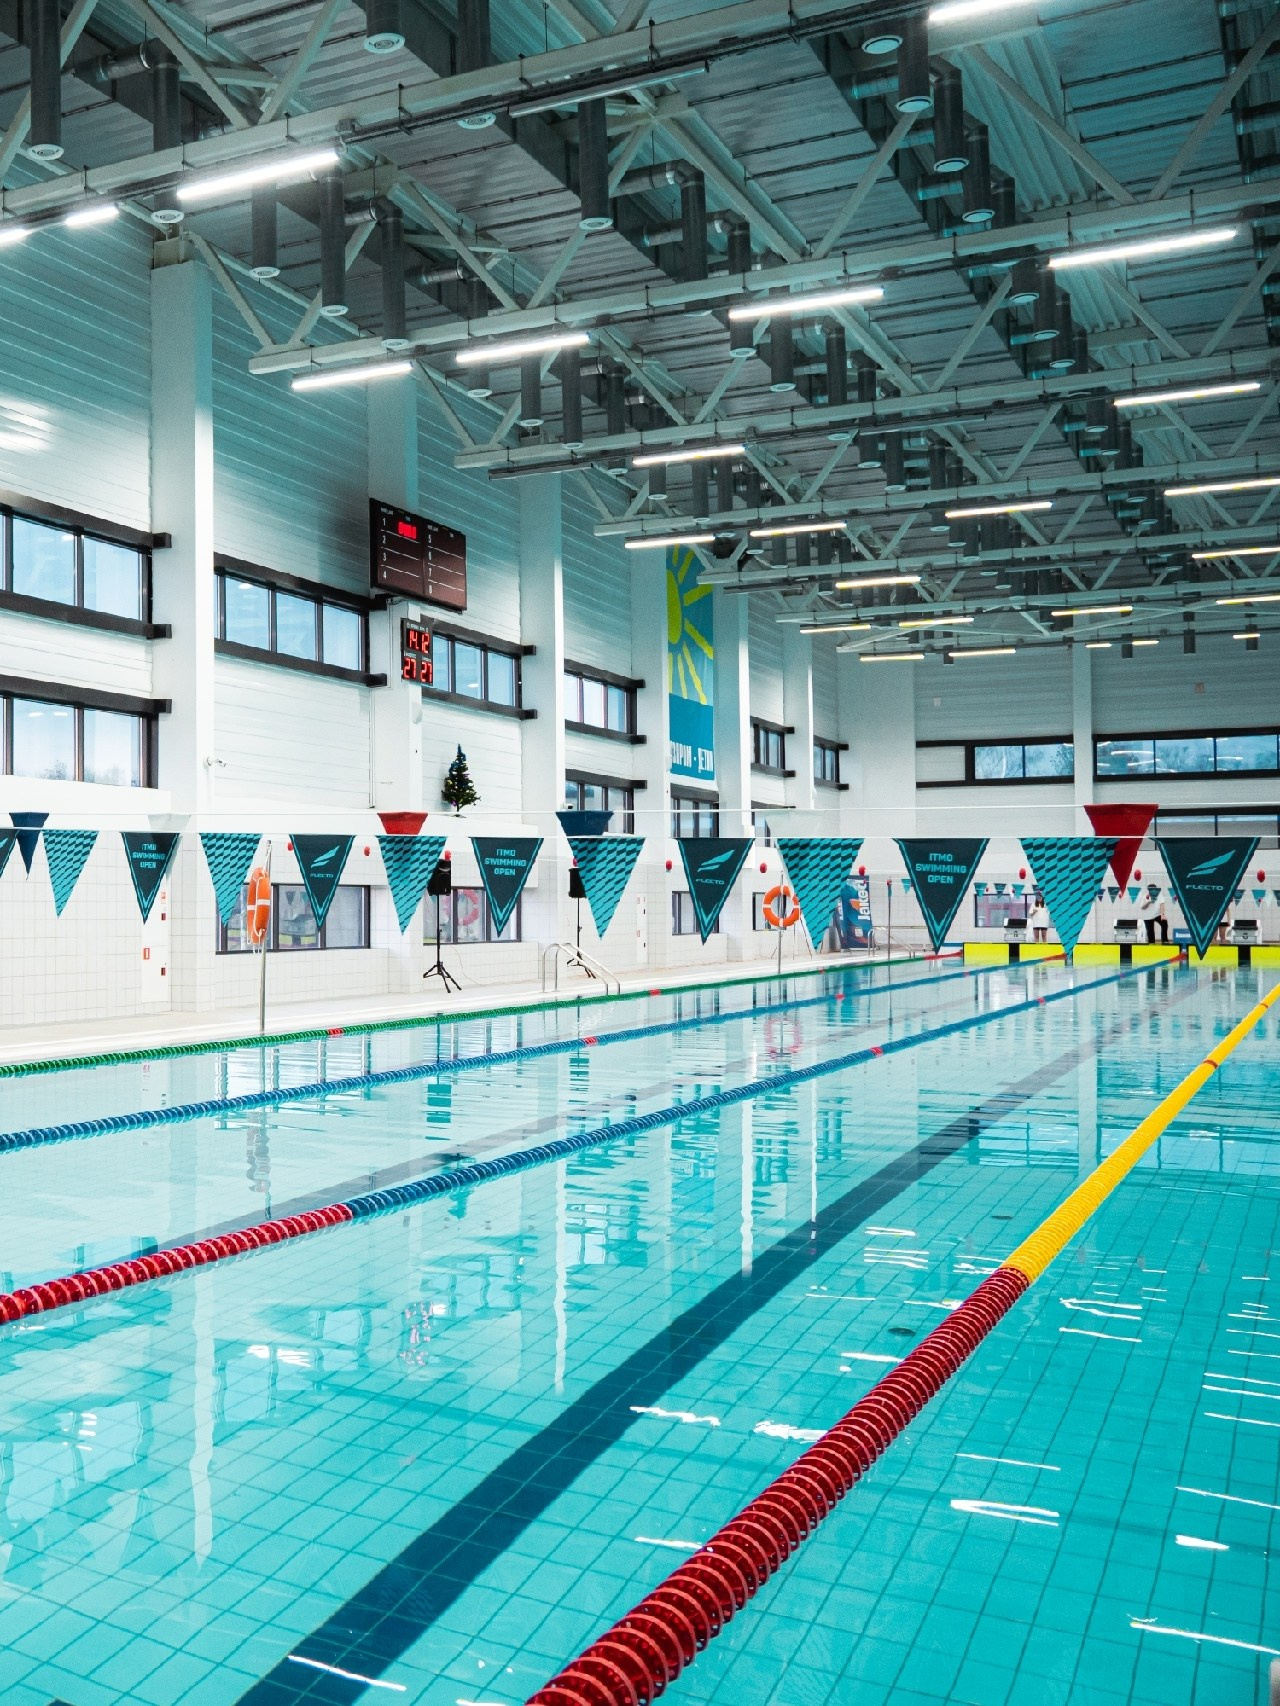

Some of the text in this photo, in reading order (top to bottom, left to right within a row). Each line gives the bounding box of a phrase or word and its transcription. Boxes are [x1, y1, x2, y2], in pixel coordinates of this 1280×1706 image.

[929, 852, 953, 862] ITMO
[494, 867, 516, 876] OPEN
[915, 863, 967, 874] SWIMMING
[927, 874, 953, 884] OPEN
